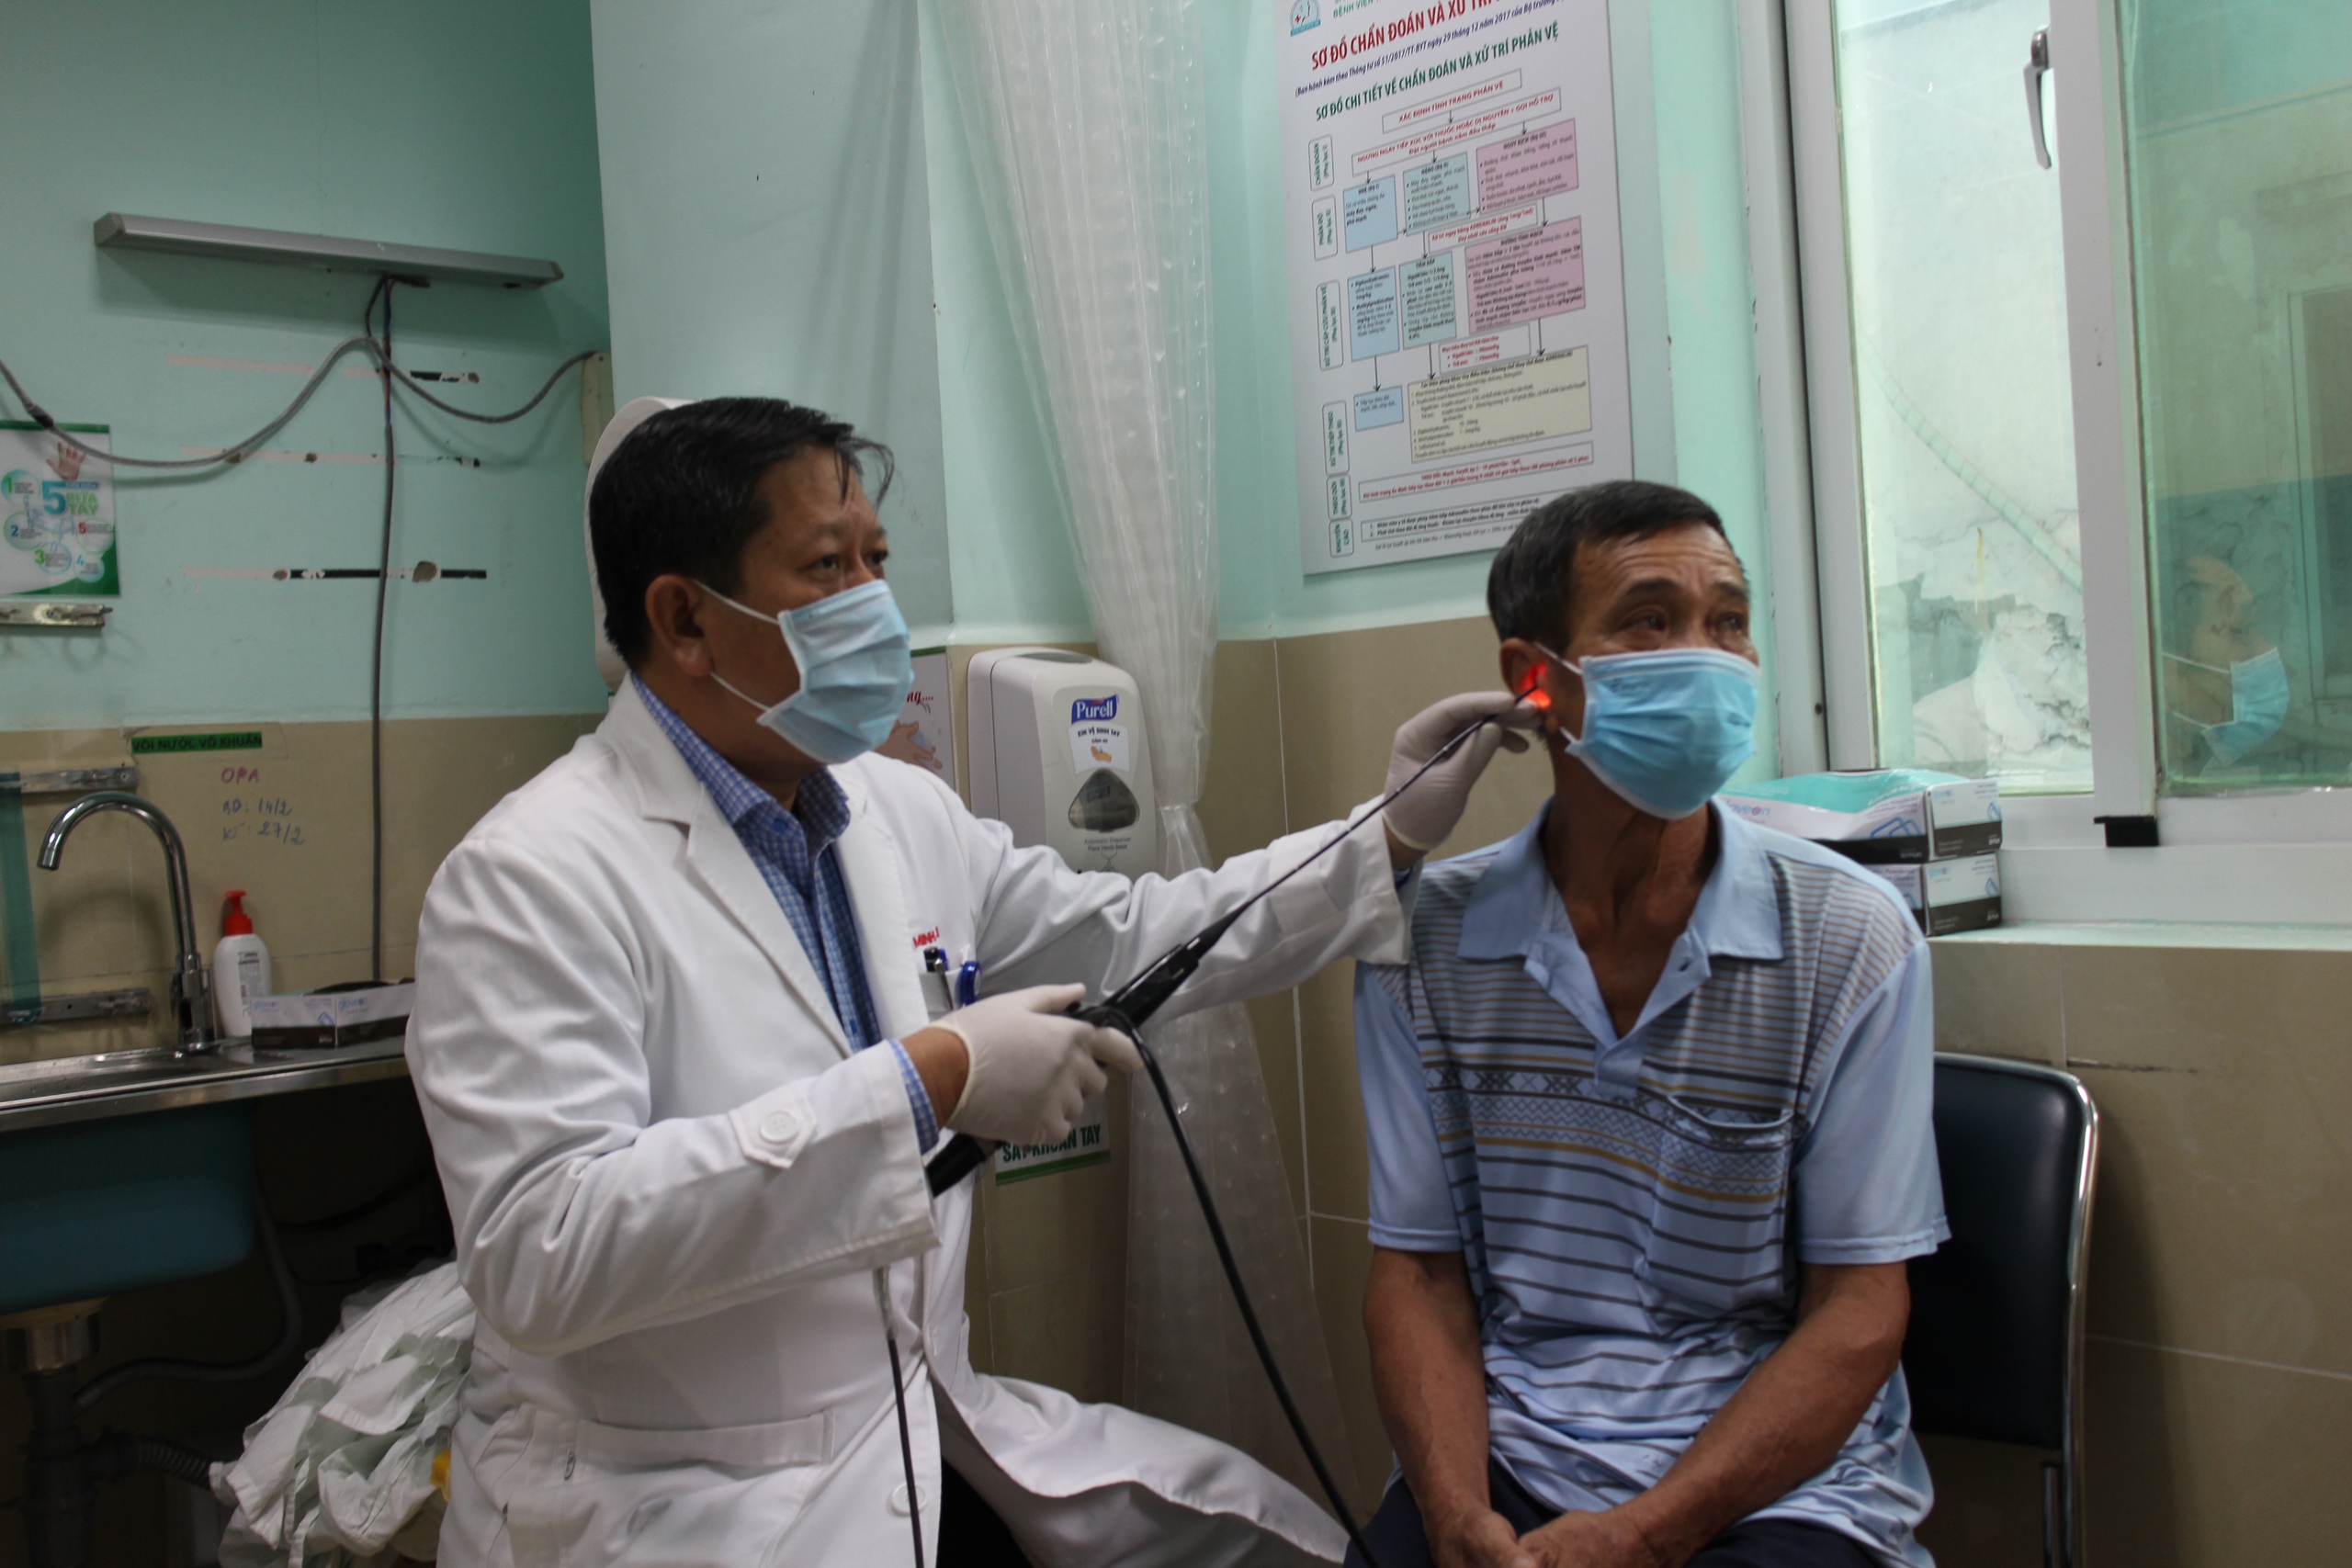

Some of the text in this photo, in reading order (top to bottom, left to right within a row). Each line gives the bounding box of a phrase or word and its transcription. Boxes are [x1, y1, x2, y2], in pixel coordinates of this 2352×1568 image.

[1312, 46, 1328, 71] SƠ
[1330, 35, 1348, 64] ĐỒ
[1351, 23, 1385, 56] CHẨN
[1387, 11, 1424, 42] ĐOÁN
[1427, 1, 1445, 27] VÀ
[1336, 72, 1349, 83] theo
[1349, 64, 1366, 77] Thông
[1427, 37, 1442, 50] ngày
[1443, 32, 1451, 43] 29
[1452, 27, 1470, 39] tháng
[1471, 22, 1478, 32] 12
[1479, 18, 1494, 29] năm
[1495, 9, 1510, 24] 2017
[1317, 19, 1559, 121] SƠ ĐỒ CHI TIẾT VỀ CHẨN ĐOÁN VÀ XỬ TRÍ PHẢN VỆ
[1398, 111, 1412, 123] XÁC
[1414, 105, 1430, 118] ĐỊNH
[41, 480, 67, 515] 5
[10, 525, 18, 537] 2
[34, 549, 45, 565] 3
[220, 766, 260, 784] OPA
[1080, 1122, 1101, 1147] TAY
